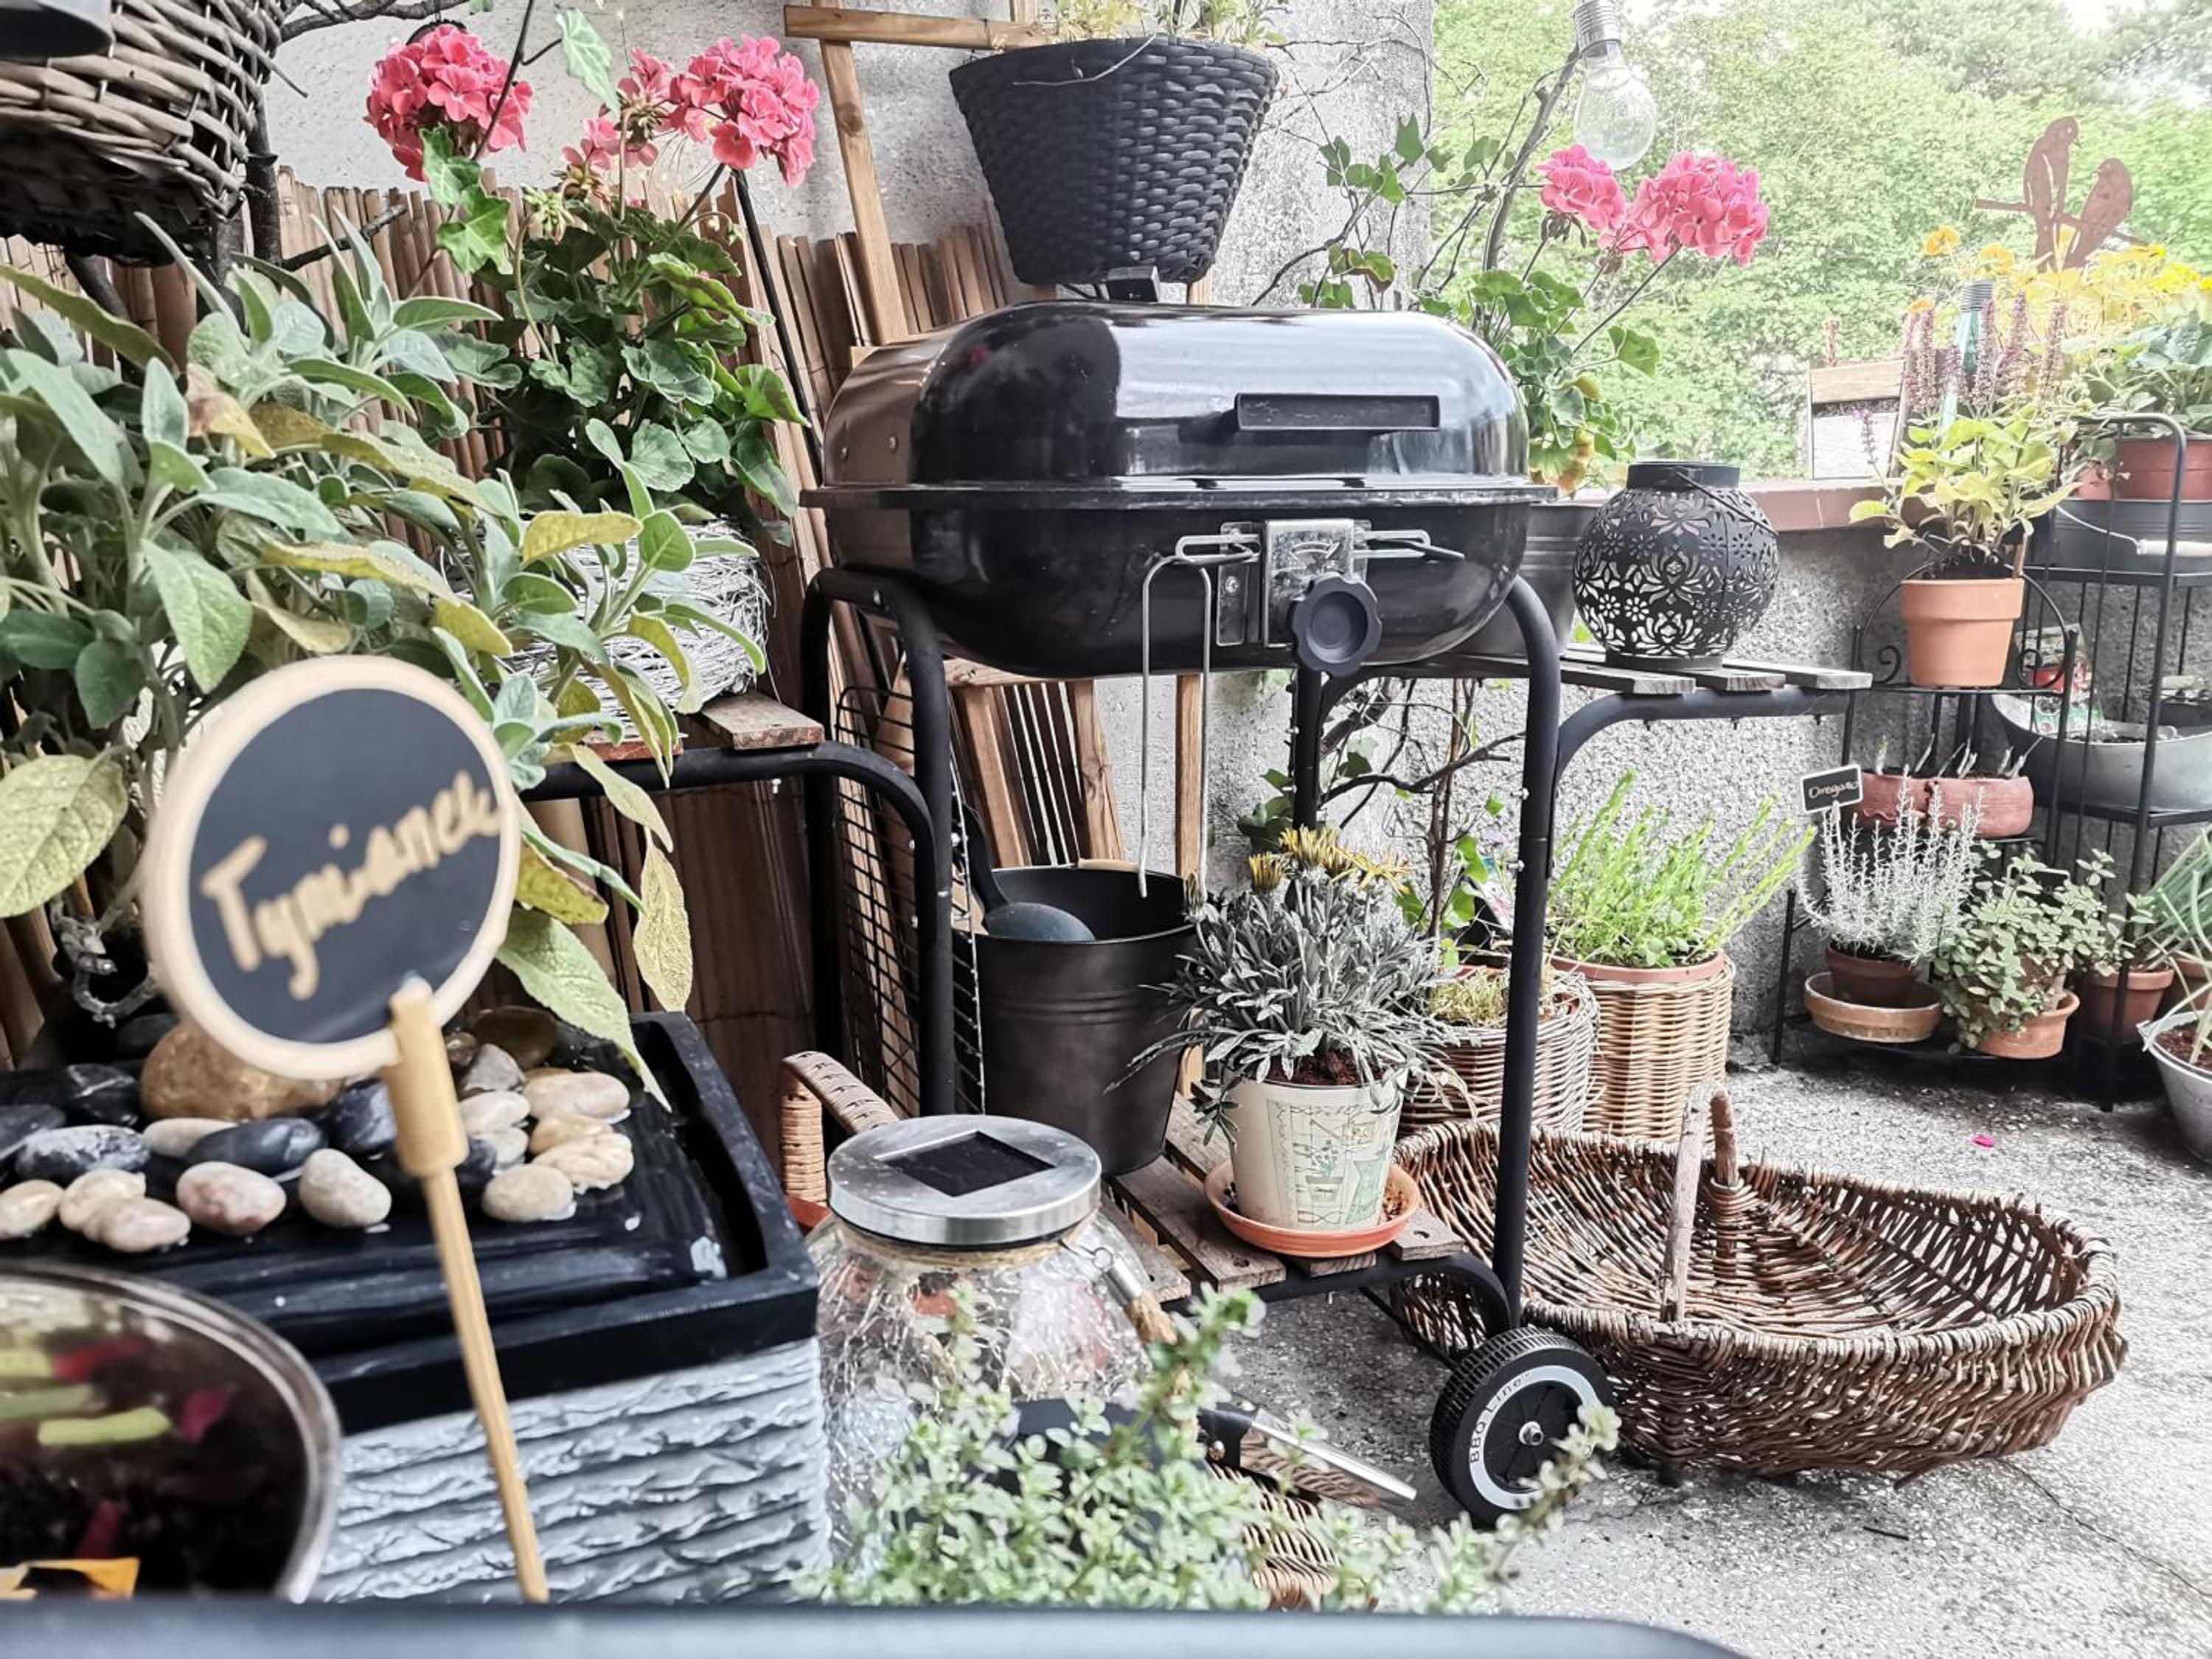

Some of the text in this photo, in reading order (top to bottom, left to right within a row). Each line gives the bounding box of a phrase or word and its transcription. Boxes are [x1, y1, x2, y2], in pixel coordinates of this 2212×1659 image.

[1809, 781, 1859, 799] Oregano
[201, 769, 501, 1001] Tymianek
[1470, 1421, 1486, 1464] BBQ
